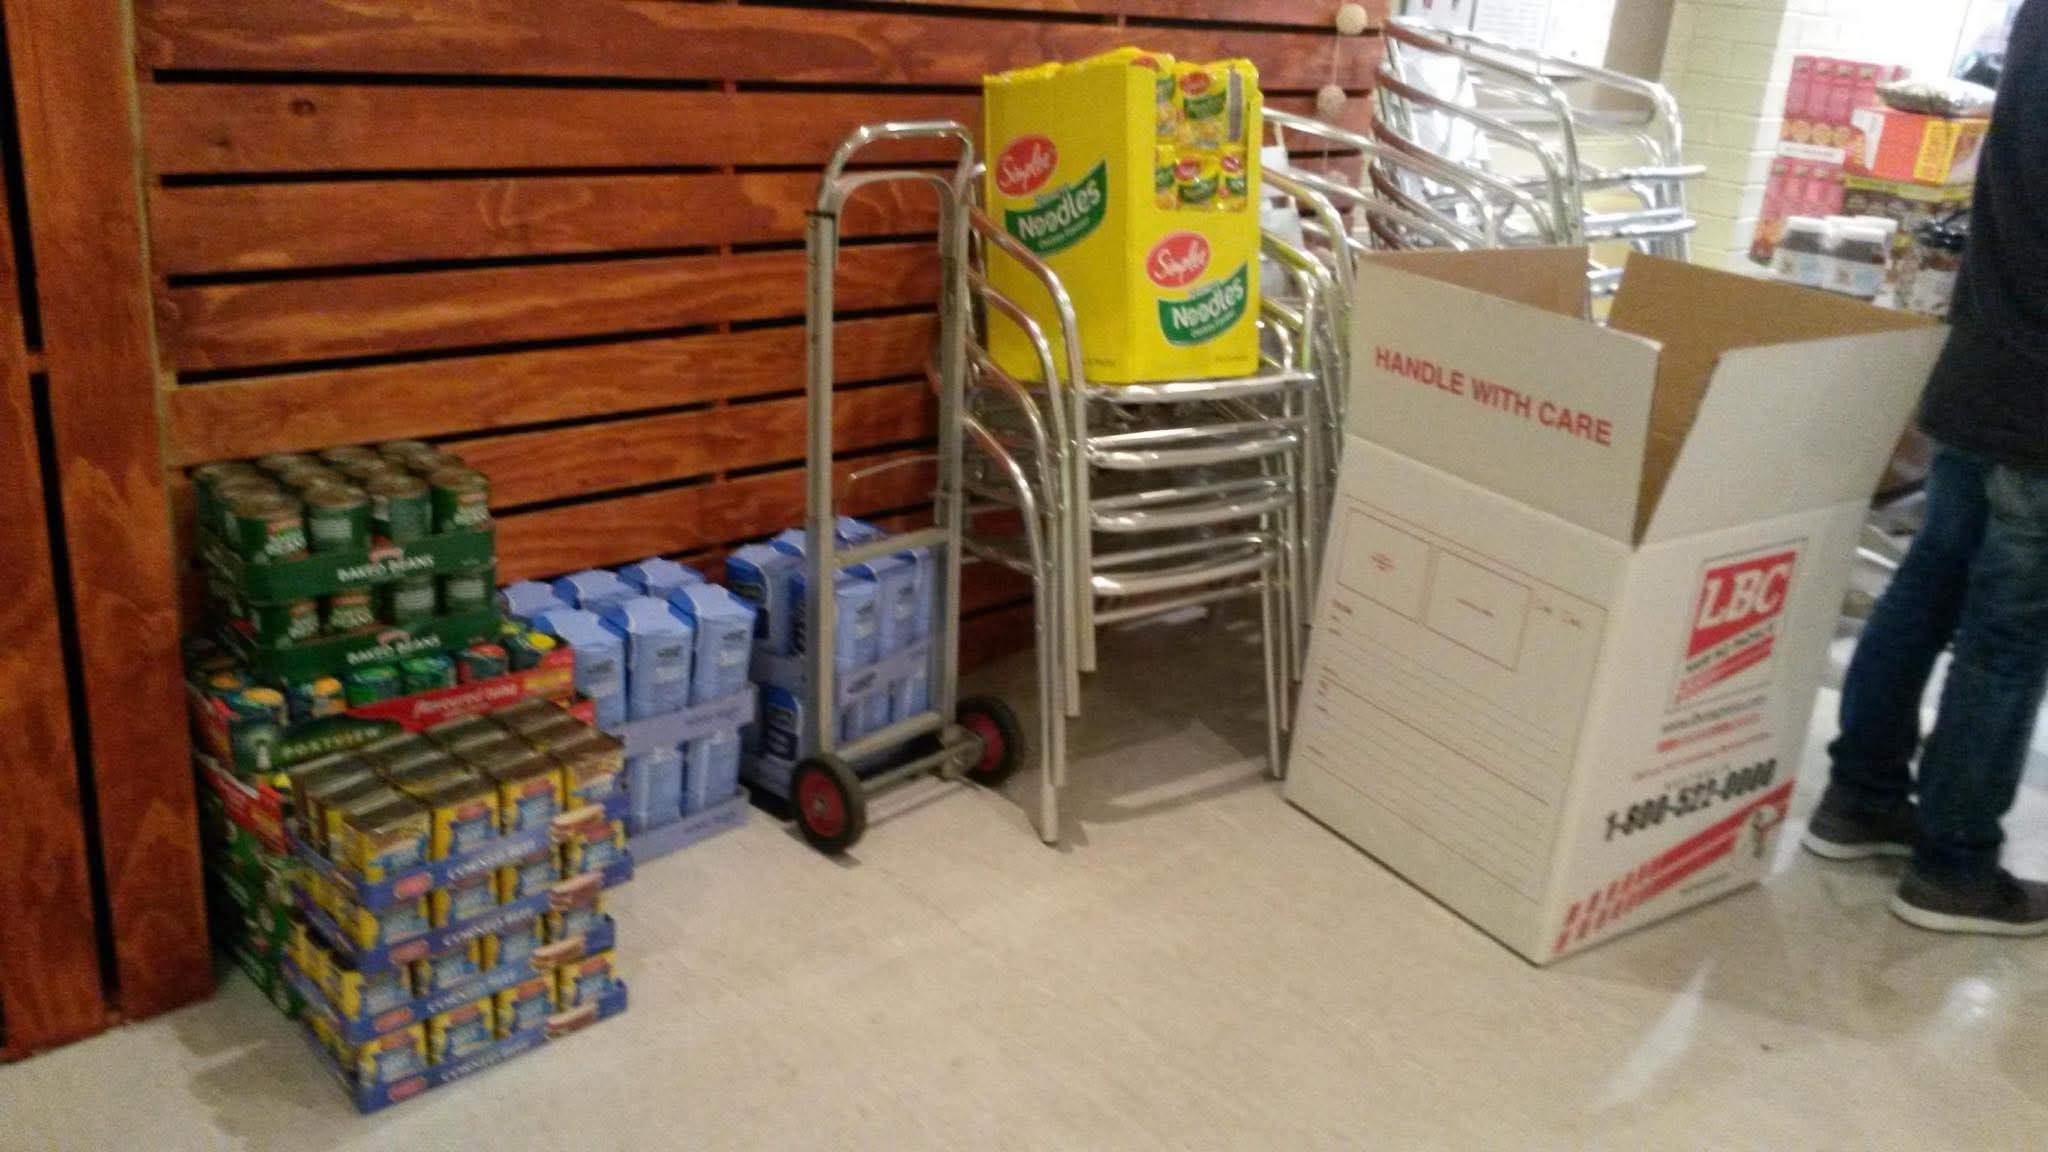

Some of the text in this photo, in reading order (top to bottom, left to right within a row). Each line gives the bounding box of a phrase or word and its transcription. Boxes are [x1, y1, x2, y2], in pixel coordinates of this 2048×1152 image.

[1017, 180, 1101, 240] Noodles
[1171, 277, 1244, 331] Noodles
[1374, 346, 1614, 448] HANDLE WITH CARE
[1696, 562, 1792, 630] LBC
